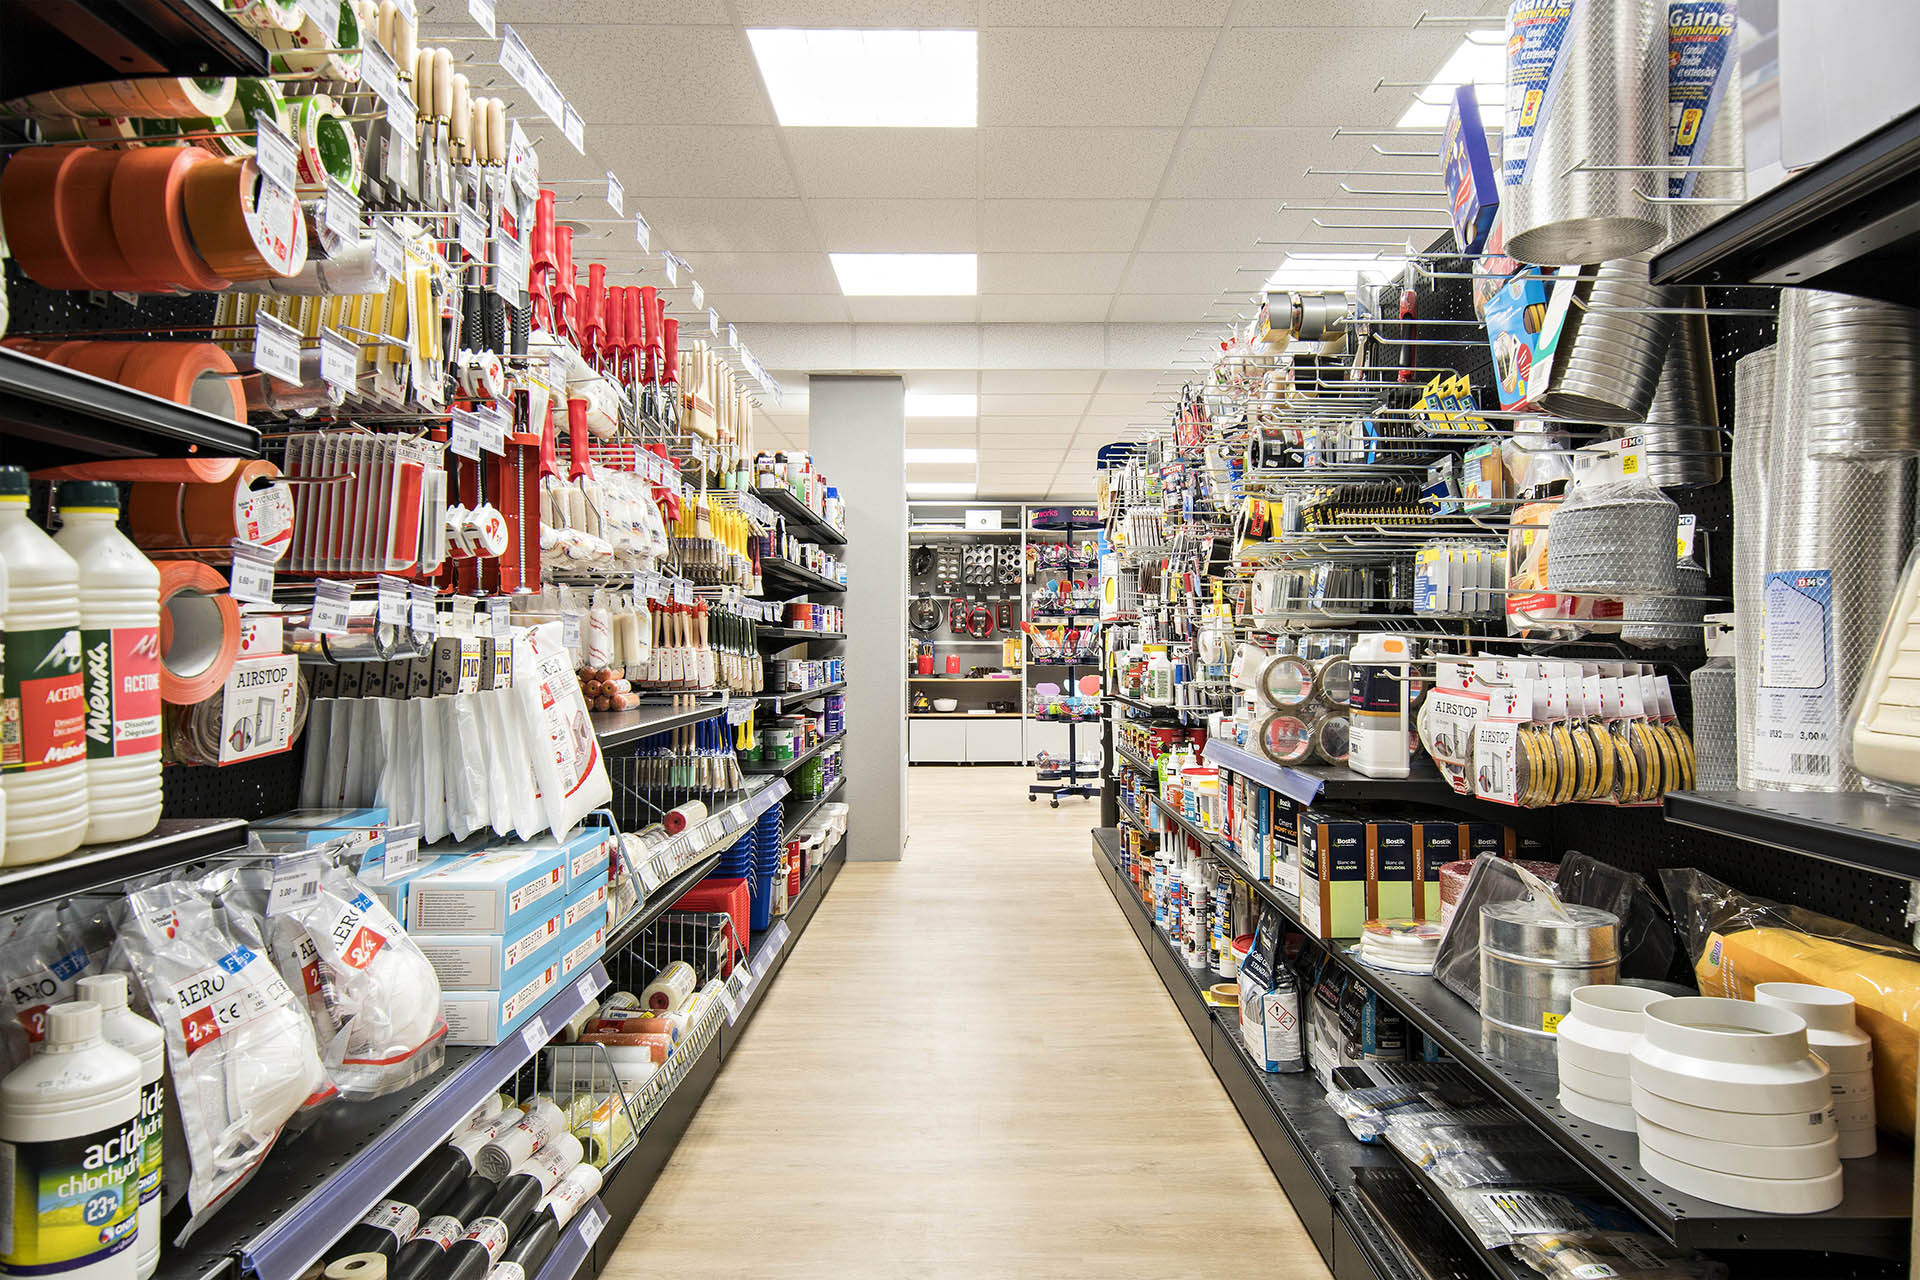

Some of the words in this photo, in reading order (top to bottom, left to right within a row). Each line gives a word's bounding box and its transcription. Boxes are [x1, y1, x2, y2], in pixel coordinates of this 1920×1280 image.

[1669, 8, 1734, 27] Gaine
[237, 667, 288, 688] AIRSTOP
[1435, 701, 1478, 719] AIRSTOP
[1480, 730, 1510, 745] AIRSTOP
[178, 975, 225, 1009] AERO
[87, 1194, 119, 1222] 23%
